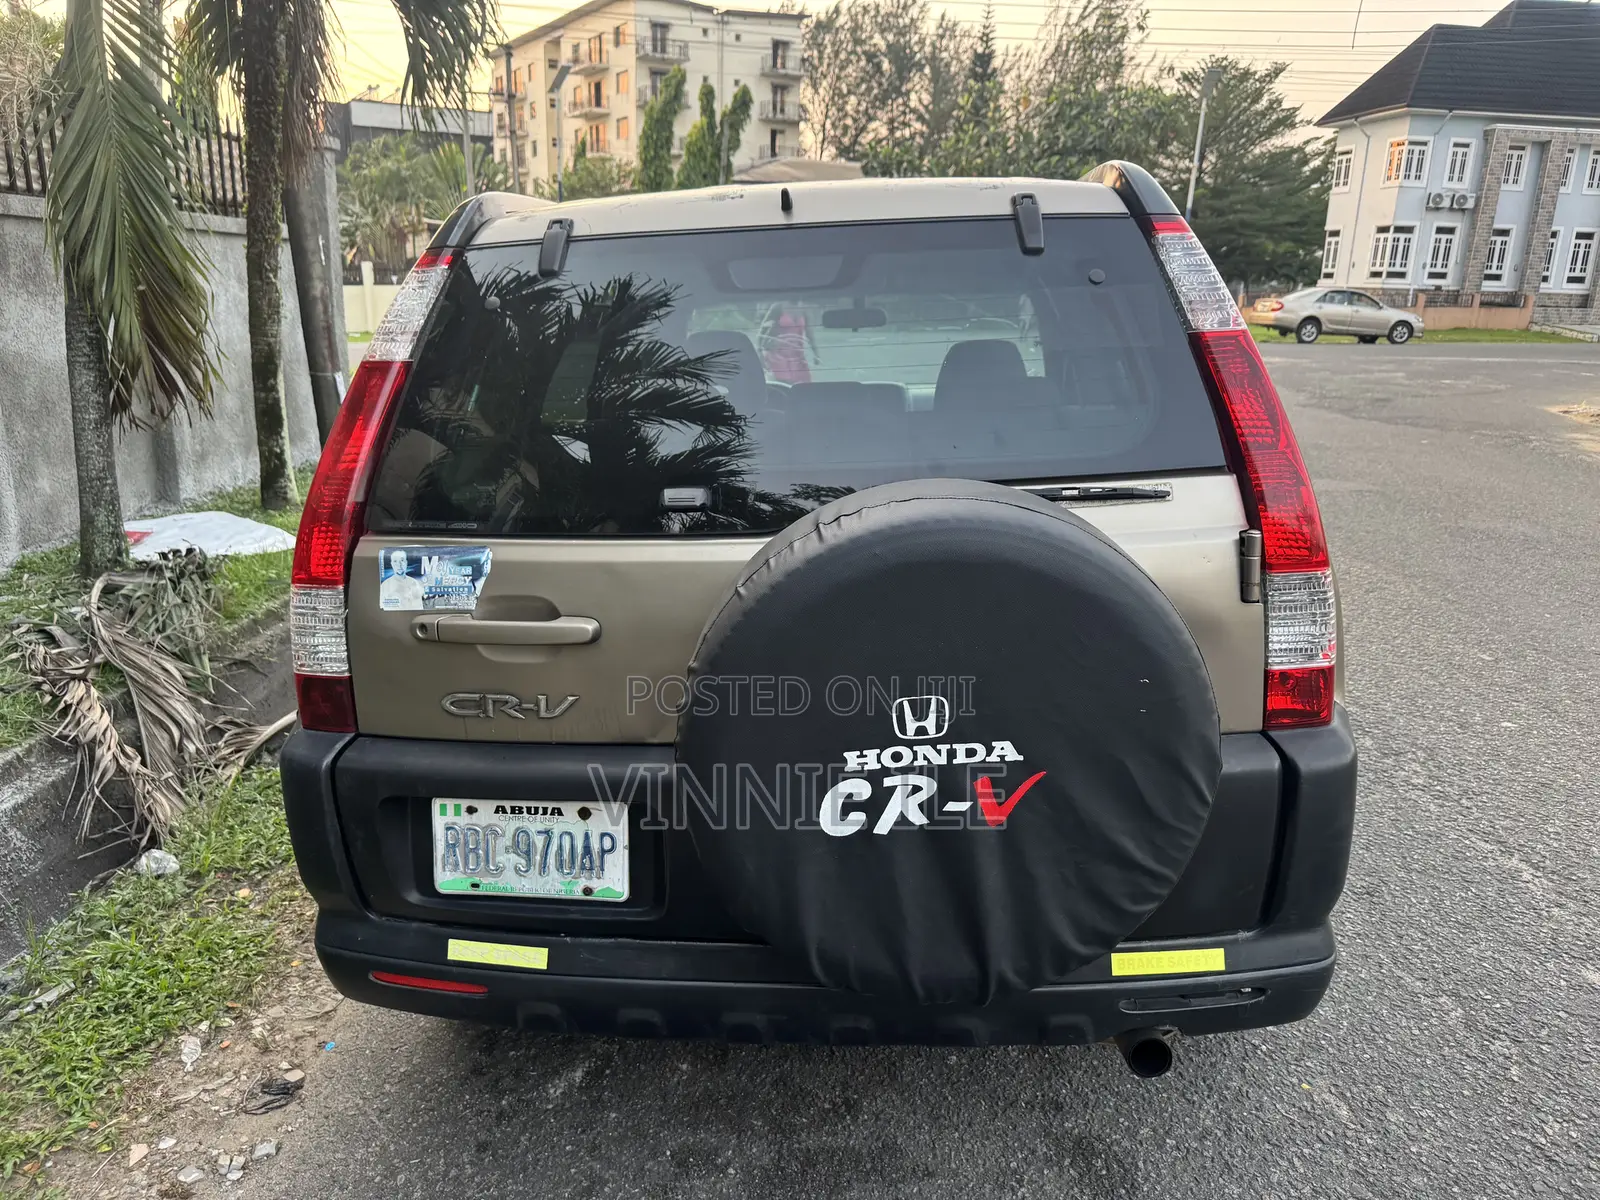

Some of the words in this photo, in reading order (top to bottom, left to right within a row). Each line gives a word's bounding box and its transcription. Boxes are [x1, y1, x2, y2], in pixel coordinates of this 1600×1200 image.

[441, 693, 580, 720] CR-V
[843, 740, 1024, 772] HONDA
[493, 805, 564, 816] ABUJA
[819, 770, 1047, 837] CR-V
[1117, 957, 1164, 971] BRAKE
